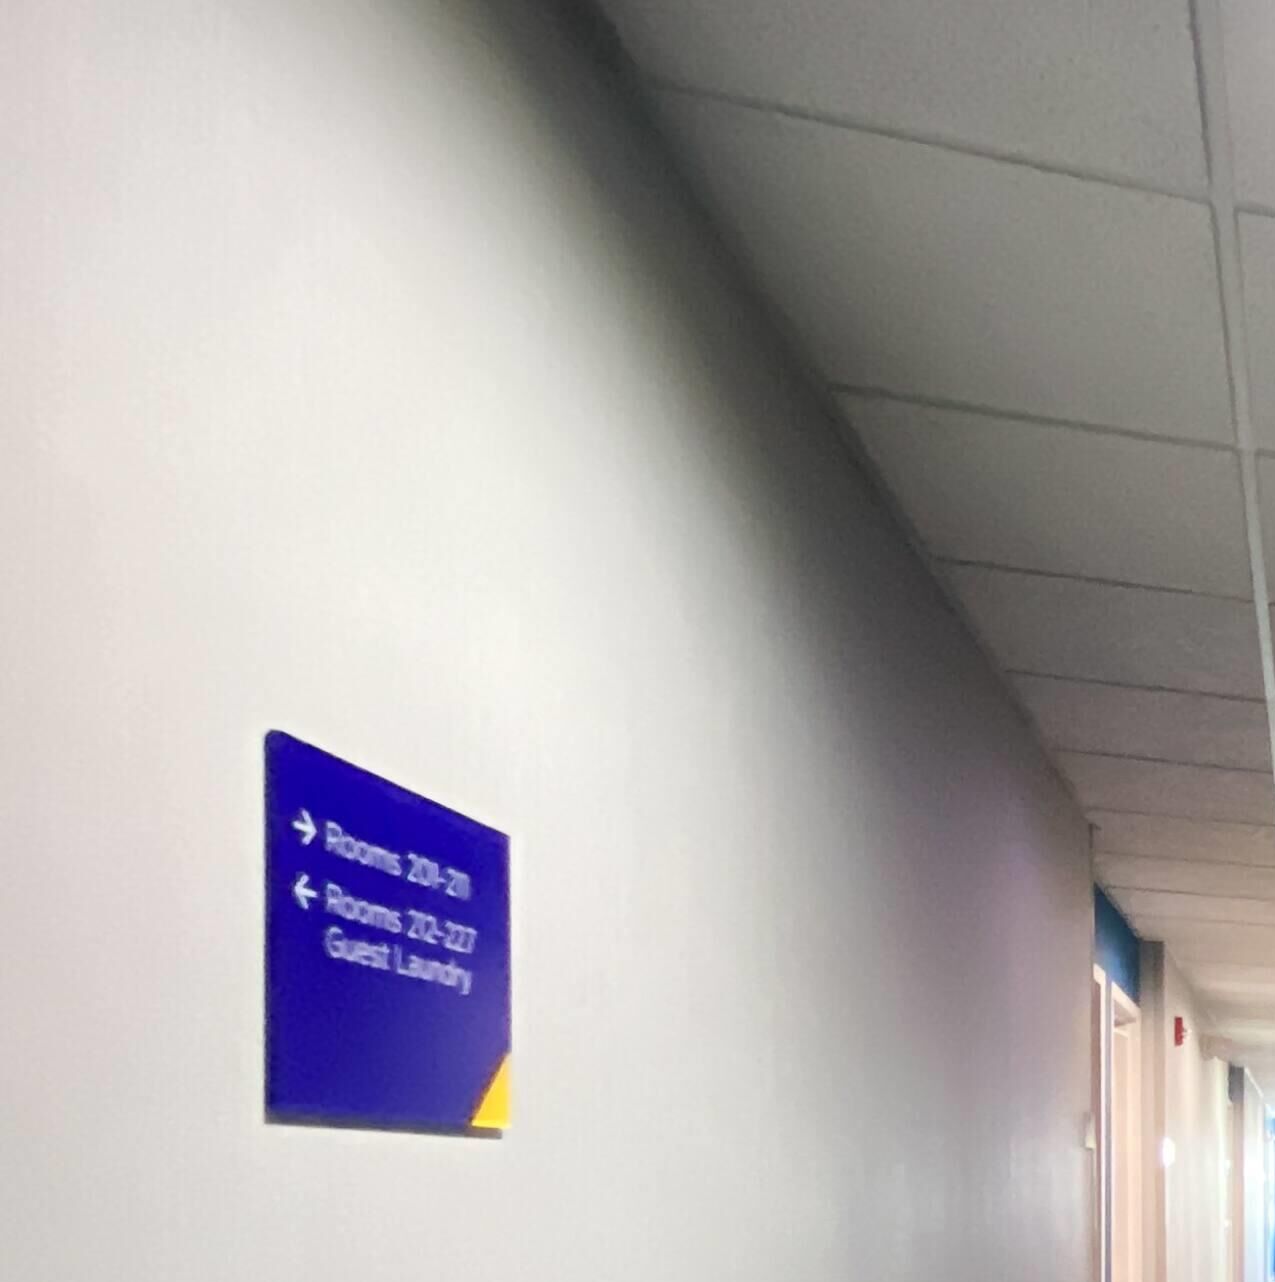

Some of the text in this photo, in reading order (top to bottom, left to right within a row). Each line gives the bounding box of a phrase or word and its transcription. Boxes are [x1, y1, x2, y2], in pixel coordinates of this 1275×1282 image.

[326, 821, 402, 876] Rooms
[326, 883, 402, 933] Rooms
[326, 926, 472, 995] Guest Laundry
